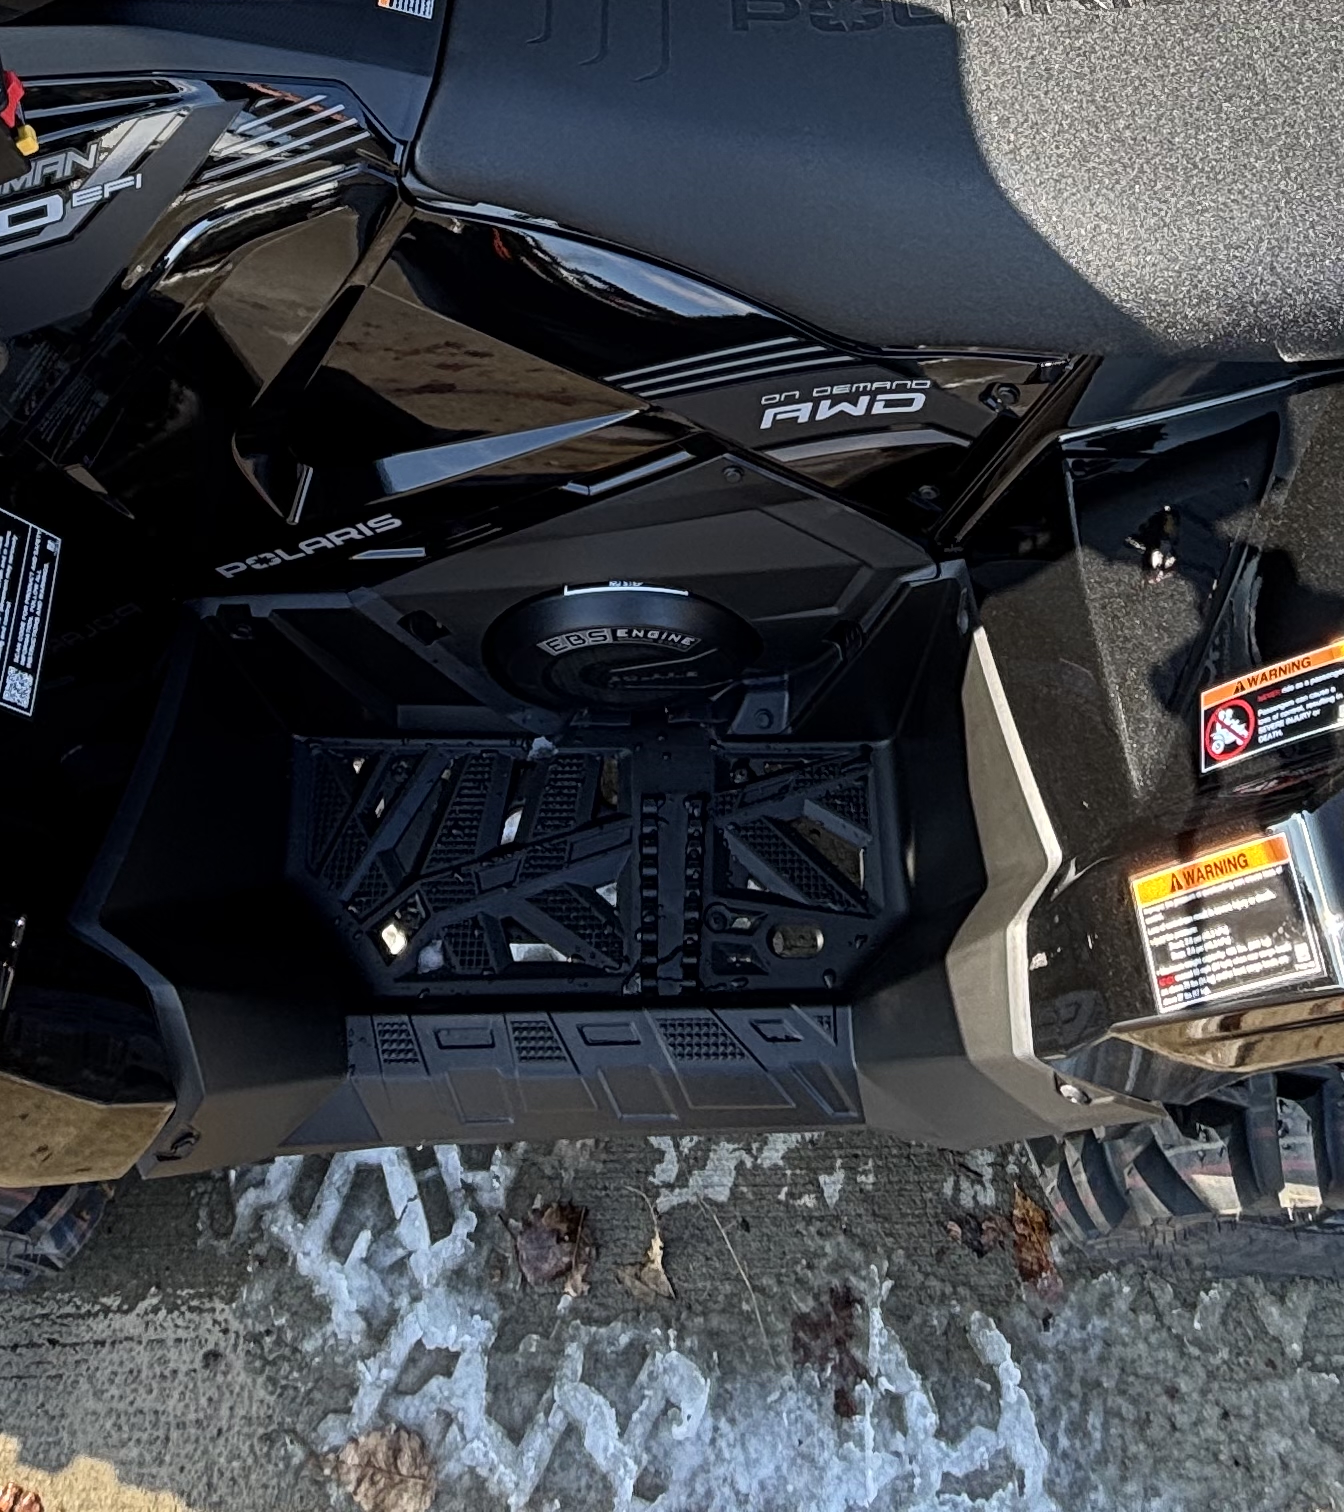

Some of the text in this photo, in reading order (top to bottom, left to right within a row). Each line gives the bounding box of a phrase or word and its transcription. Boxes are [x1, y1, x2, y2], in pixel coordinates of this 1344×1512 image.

[72, 173, 142, 208] EFI
[761, 380, 931, 405] ON DEMAND
[760, 392, 926, 429] AWD
[215, 513, 402, 578] POLARIS
[545, 628, 696, 653] EBS ENGINE
[1247, 657, 1310, 686] WARNING
[1182, 853, 1247, 884] WARNING
